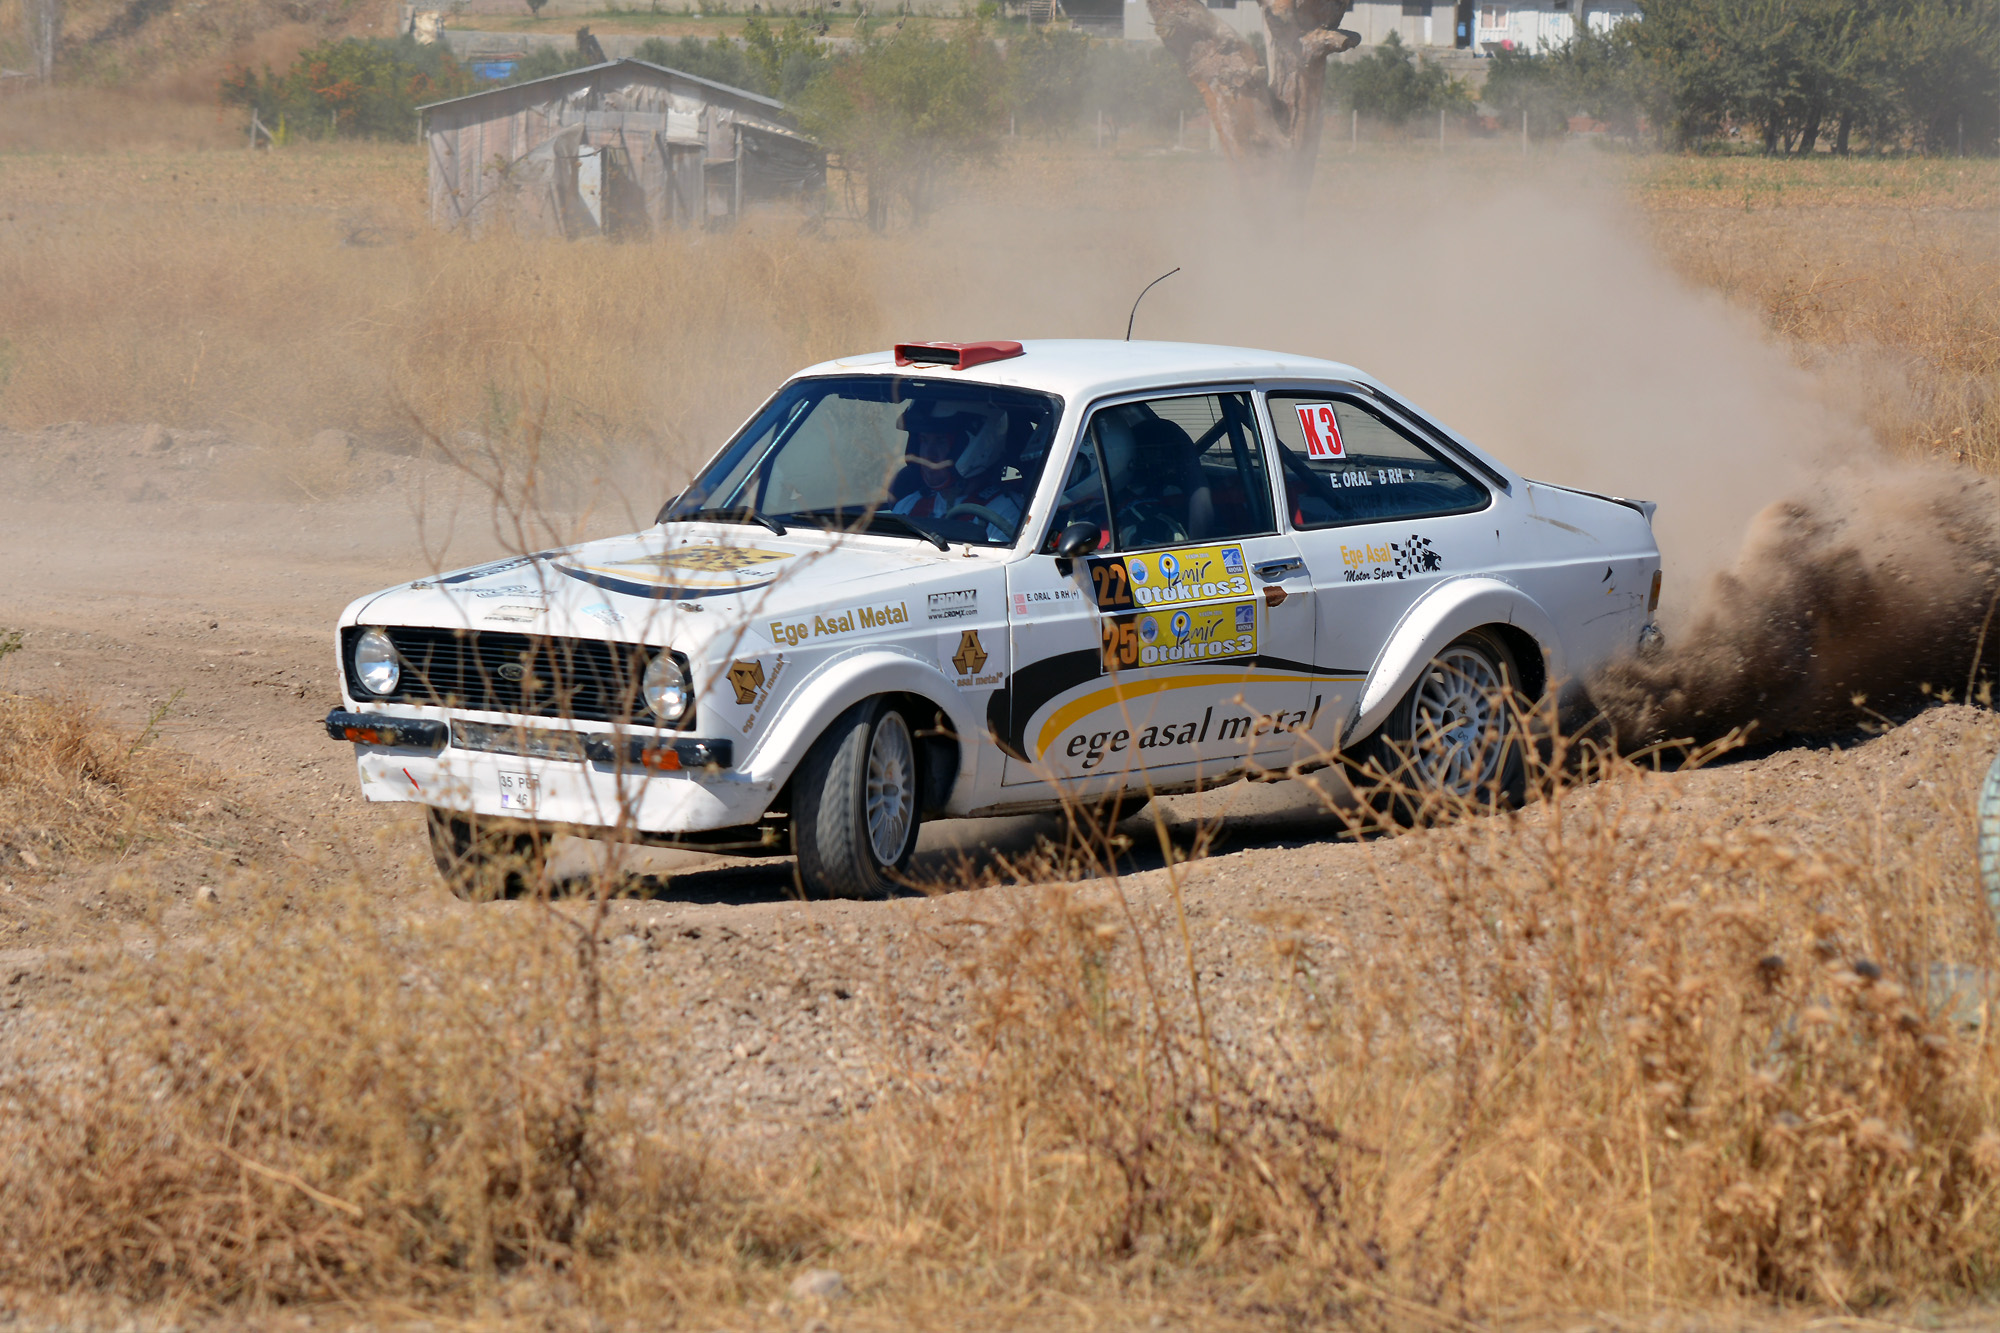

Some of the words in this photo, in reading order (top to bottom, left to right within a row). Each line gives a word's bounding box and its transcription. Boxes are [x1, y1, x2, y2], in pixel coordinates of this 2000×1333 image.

[1298, 407, 1342, 456] K3
[1330, 473, 1342, 489] E.
[1343, 471, 1372, 487] ORAL
[1378, 469, 1387, 485] B
[1389, 468, 1404, 484] RH
[1340, 545, 1363, 569] Ege
[1366, 542, 1392, 564] Asal
[1092, 563, 1131, 606] 22
[1344, 569, 1371, 582] Motor
[1373, 567, 1394, 582] Spor
[1026, 593, 1033, 602] E.
[1034, 591, 1051, 601] ORAL
[1055, 591, 1060, 600] B
[1060, 590, 1070, 599] RH
[1134, 576, 1248, 606] Otokros3
[769, 621, 808, 646] Ege
[814, 610, 855, 637] Asal
[858, 601, 909, 629] Metal
[1103, 622, 1138, 667] 25
[1141, 634, 1253, 664] Otokros3
[957, 674, 974, 687] asal
[742, 713, 755, 734] ege
[754, 688, 769, 713] asal
[1066, 729, 1130, 769] ege
[1139, 706, 1213, 749] asal
[500, 775, 513, 788] 35
[516, 793, 528, 806] 46
